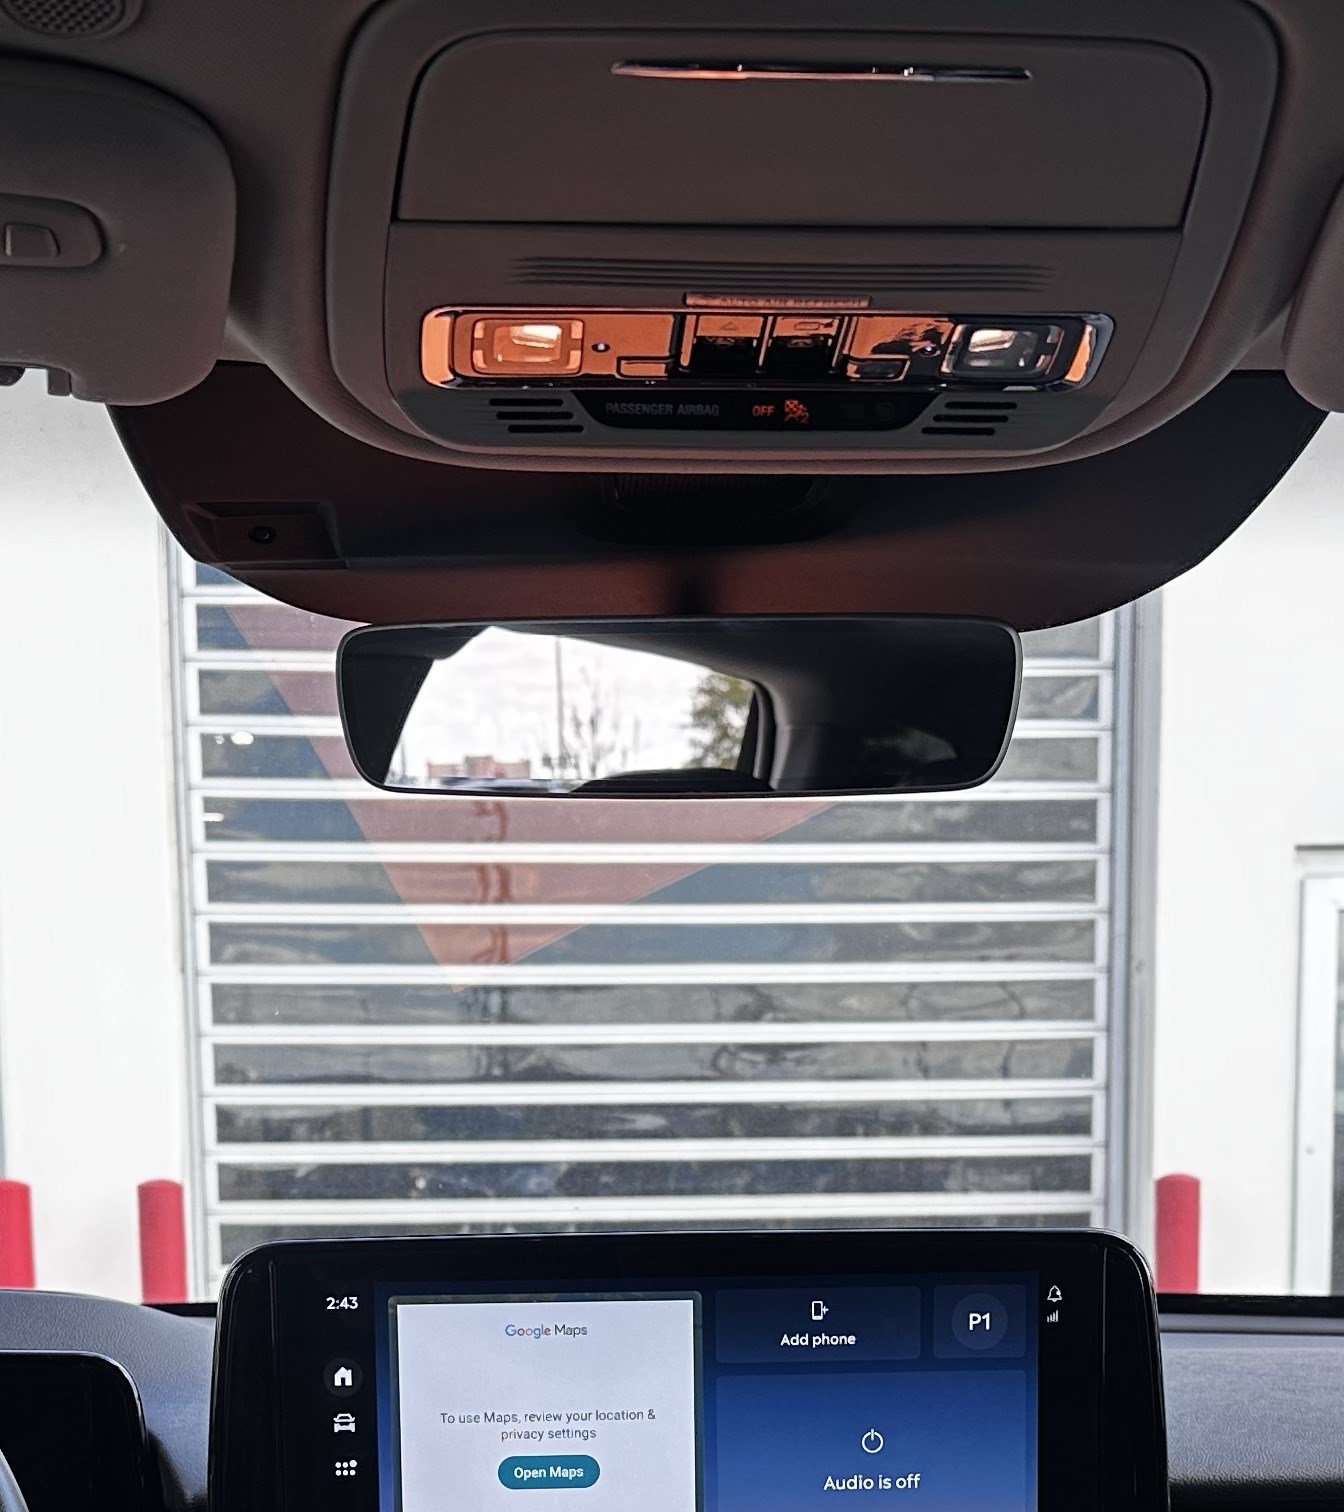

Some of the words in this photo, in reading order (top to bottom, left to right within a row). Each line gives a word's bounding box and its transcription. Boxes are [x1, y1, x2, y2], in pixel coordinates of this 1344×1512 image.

[605, 400, 673, 416] PASSENGER
[676, 401, 720, 417] AIRBAG
[751, 404, 776, 418] OFF
[326, 1296, 359, 1310] 2:43
[968, 1312, 991, 1330] P1
[504, 1323, 552, 1339] Google
[554, 1323, 588, 1338] Maps
[780, 1333, 809, 1346] Add
[812, 1333, 857, 1348] phone
[440, 1412, 455, 1424] To
[458, 1414, 480, 1424] use
[484, 1411, 521, 1426] Maps,
[524, 1411, 562, 1423] review
[566, 1412, 592, 1424] your
[595, 1409, 643, 1421] location
[647, 1408, 656, 1420] &
[501, 1429, 544, 1442] privacy
[547, 1427, 597, 1441] settings
[514, 1466, 546, 1481] Open
[550, 1465, 584, 1481] Maps
[823, 1474, 874, 1490] Audio
[878, 1474, 892, 1490] is
[895, 1473, 921, 1489] off
